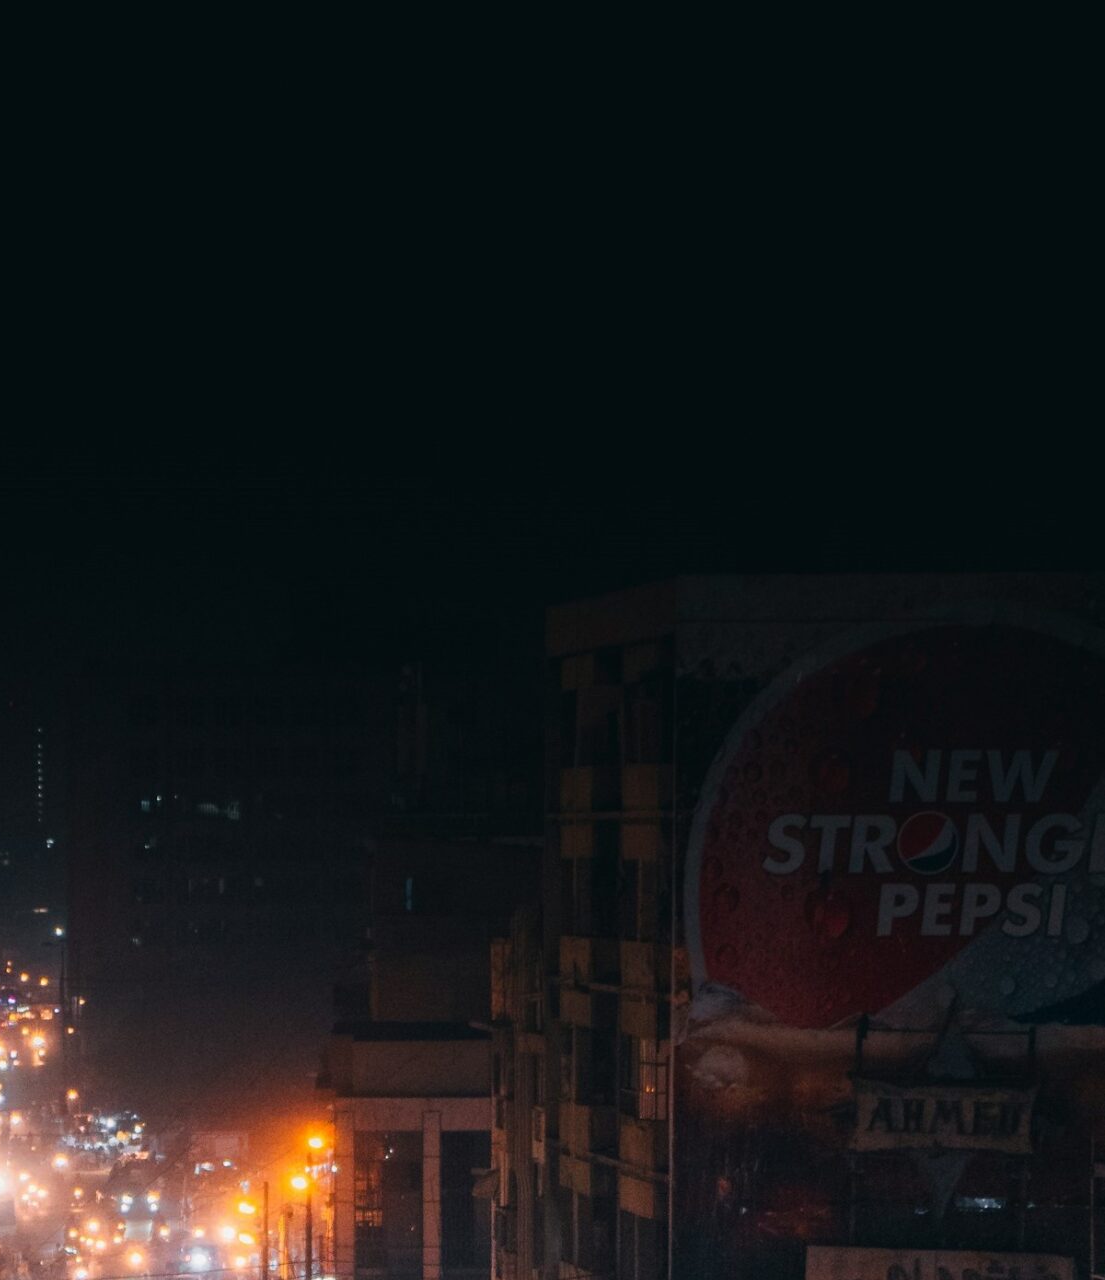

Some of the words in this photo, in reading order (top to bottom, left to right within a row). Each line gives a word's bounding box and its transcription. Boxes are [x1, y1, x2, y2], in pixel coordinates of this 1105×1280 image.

[888, 748, 1059, 804] NEW
[876, 882, 1068, 938] PEPSI
[867, 1097, 1023, 1136] AHMED
